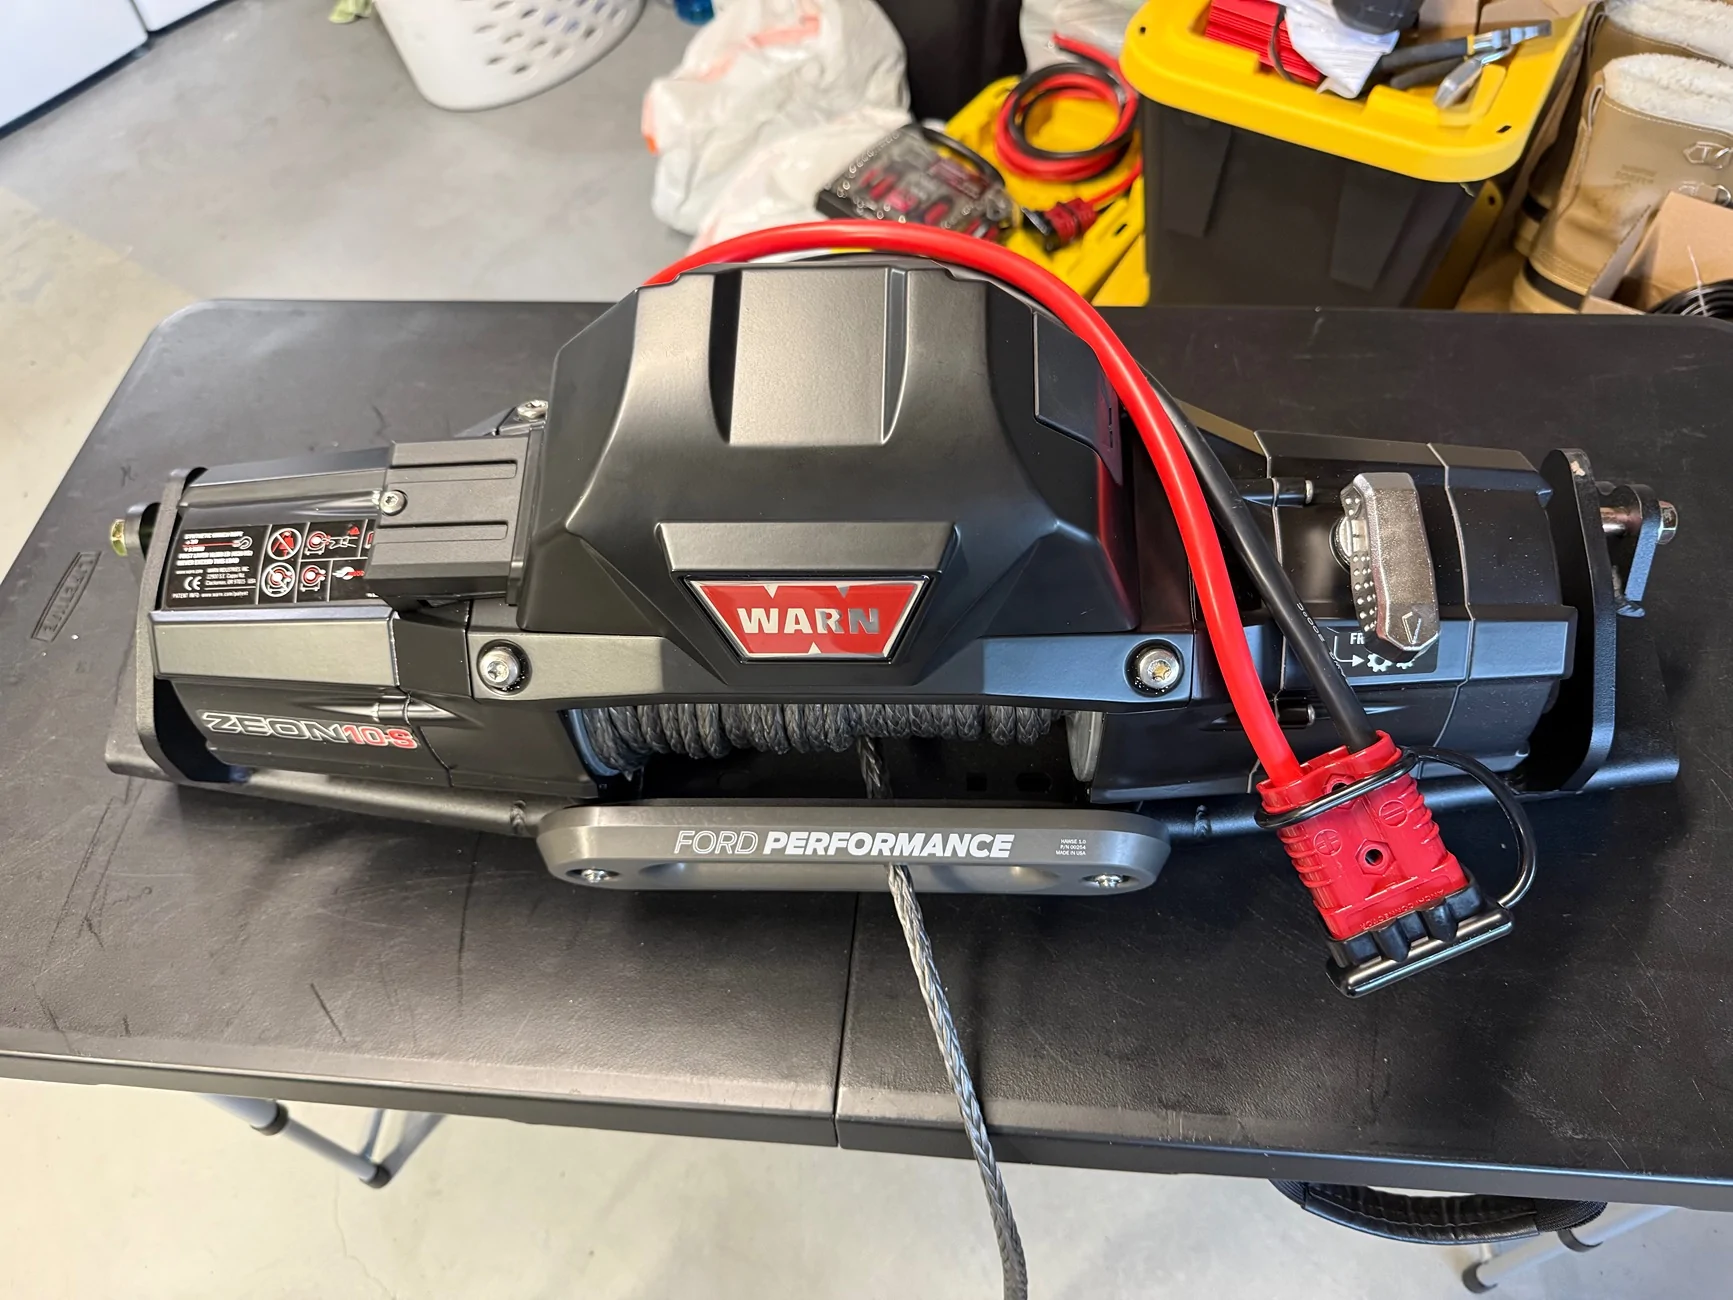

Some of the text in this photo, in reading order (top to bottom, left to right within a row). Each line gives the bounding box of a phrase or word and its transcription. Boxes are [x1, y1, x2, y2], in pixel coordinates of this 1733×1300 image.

[736, 607, 880, 635] WARN
[1349, 632, 1366, 645] FR
[673, 830, 1015, 858] FORD PERFORMANCE
